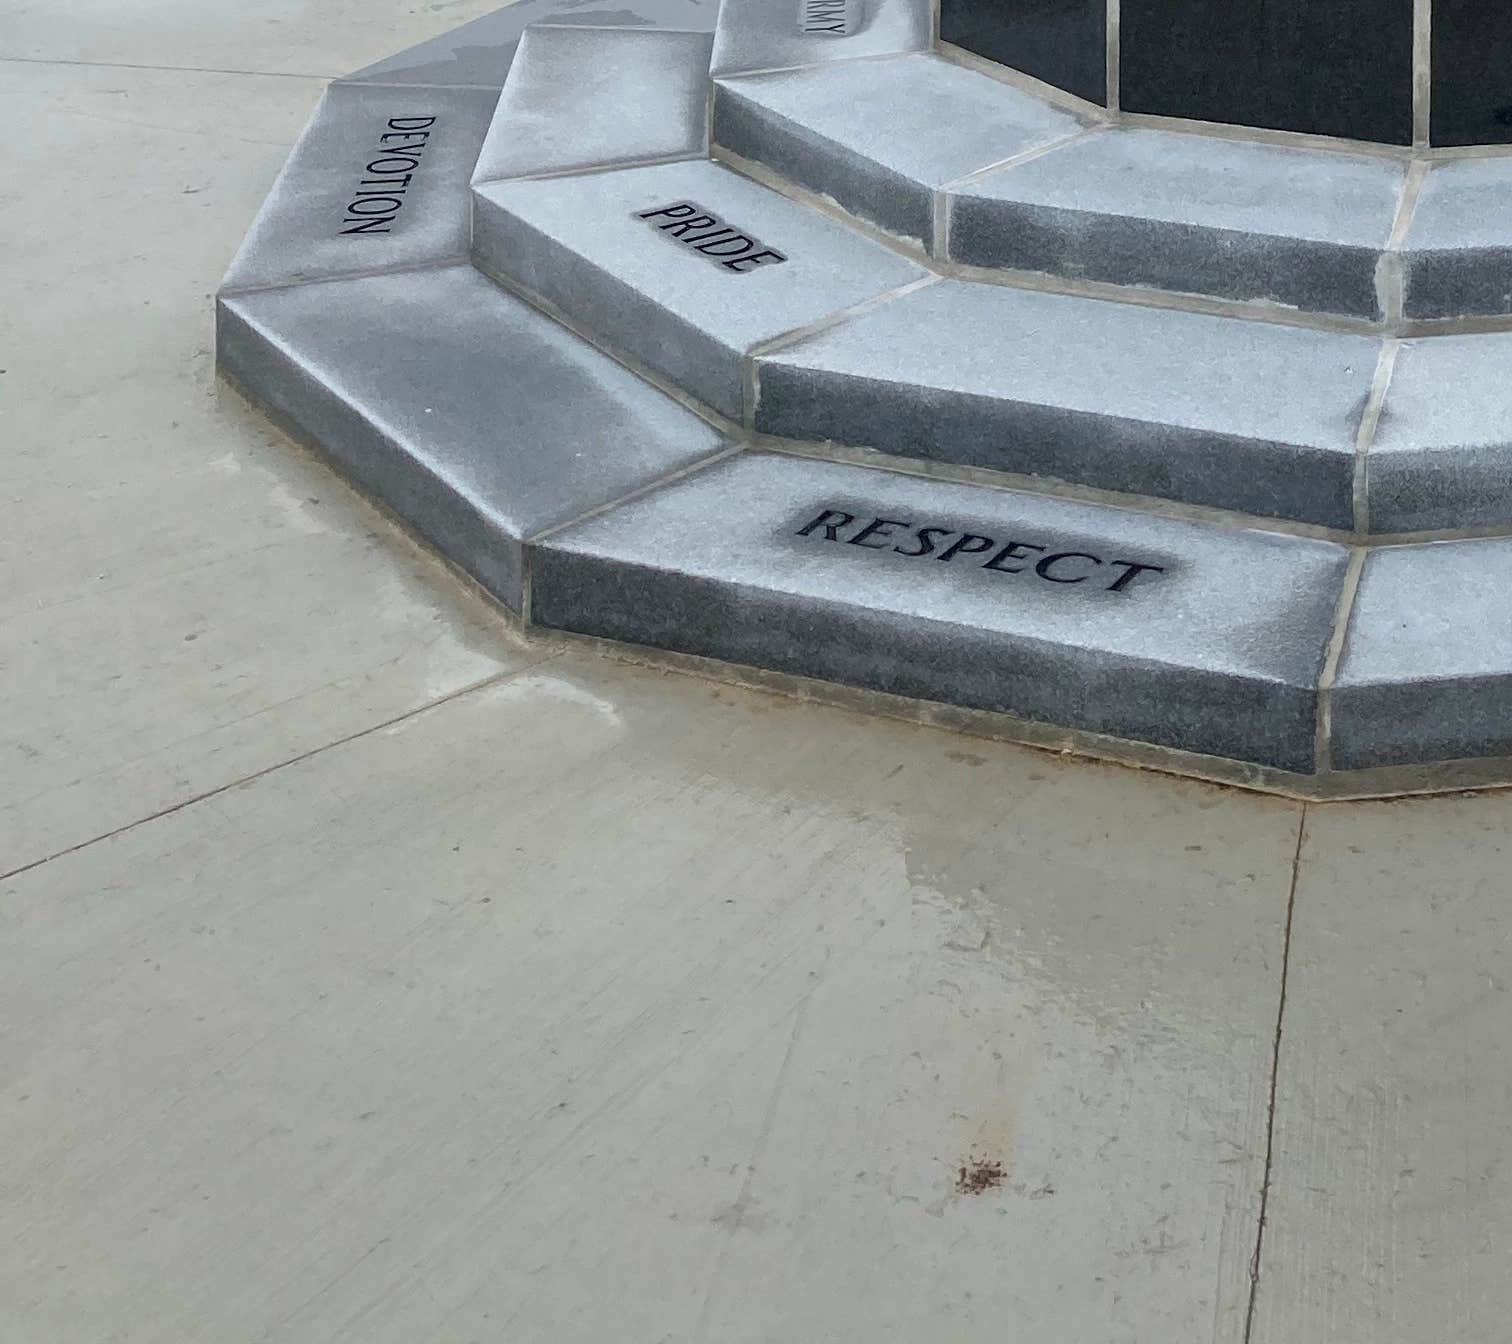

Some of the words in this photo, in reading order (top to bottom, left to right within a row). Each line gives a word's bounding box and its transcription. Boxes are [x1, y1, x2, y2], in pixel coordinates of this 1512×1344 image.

[338, 116, 437, 235] DEVOTION
[639, 204, 786, 272] PRIDE
[795, 509, 1164, 592] RESPECT
